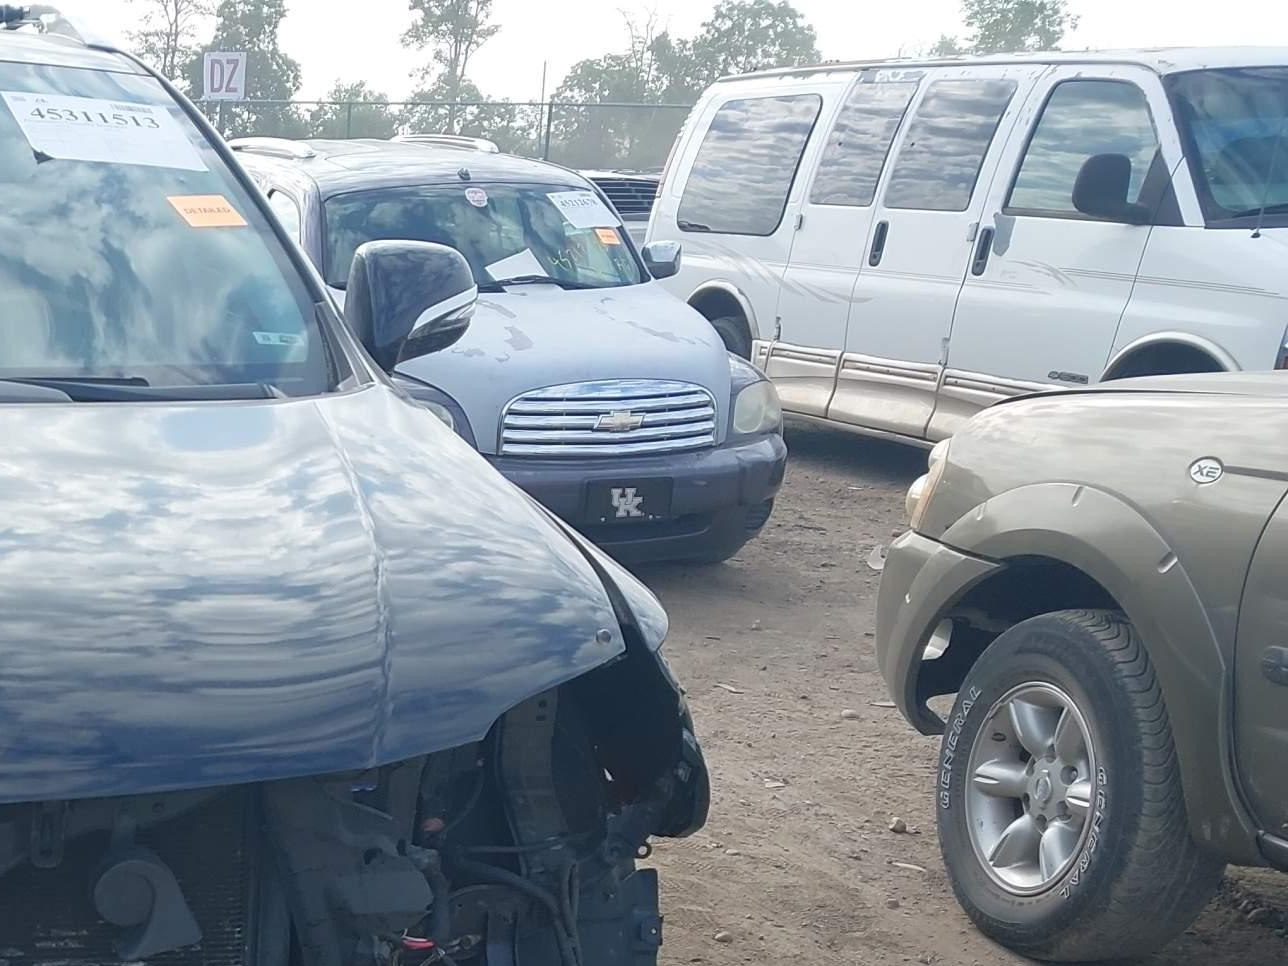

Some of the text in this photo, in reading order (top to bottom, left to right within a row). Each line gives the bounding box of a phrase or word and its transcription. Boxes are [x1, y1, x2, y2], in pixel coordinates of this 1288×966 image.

[210, 58, 239, 93] DZ
[30, 107, 160, 129] 45311513
[1192, 464, 1220, 478] XE
[940, 686, 982, 809] GENERAL
[1058, 766, 1108, 898] GENERAL
